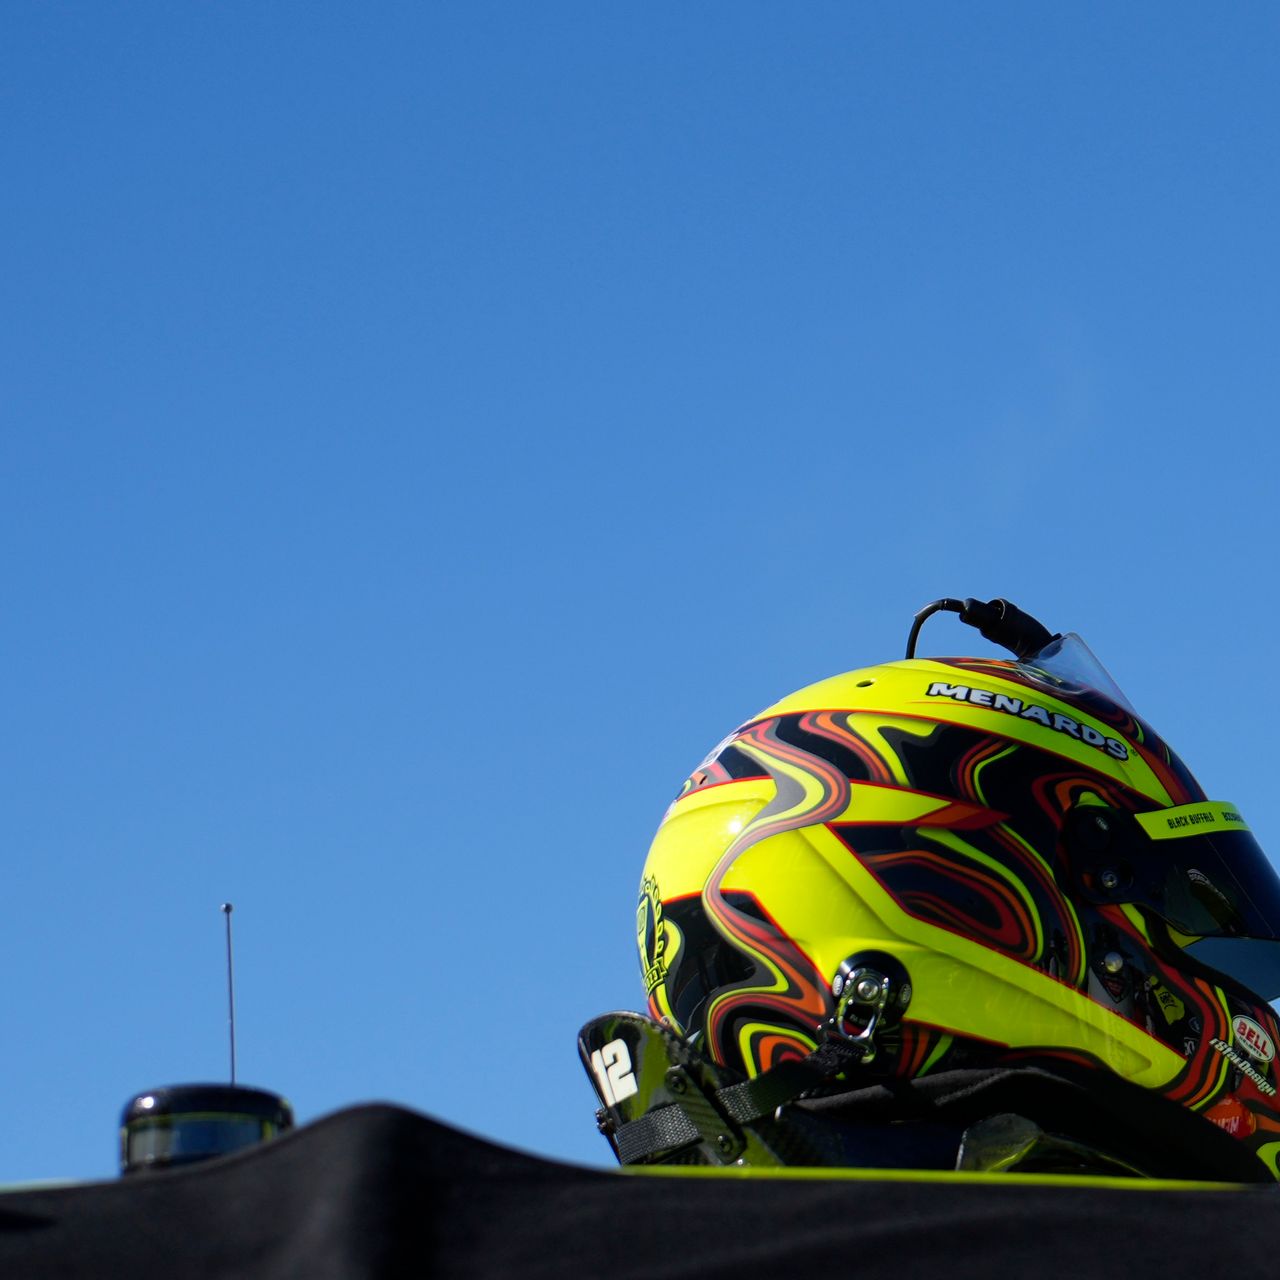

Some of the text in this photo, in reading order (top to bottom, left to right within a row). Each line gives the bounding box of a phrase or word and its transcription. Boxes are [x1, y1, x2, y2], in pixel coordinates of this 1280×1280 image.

[927, 682, 1129, 760] MENARDS
[1167, 815, 1188, 829] BLACK
[1237, 1021, 1270, 1056] BELL
[591, 1038, 638, 1108] 12
